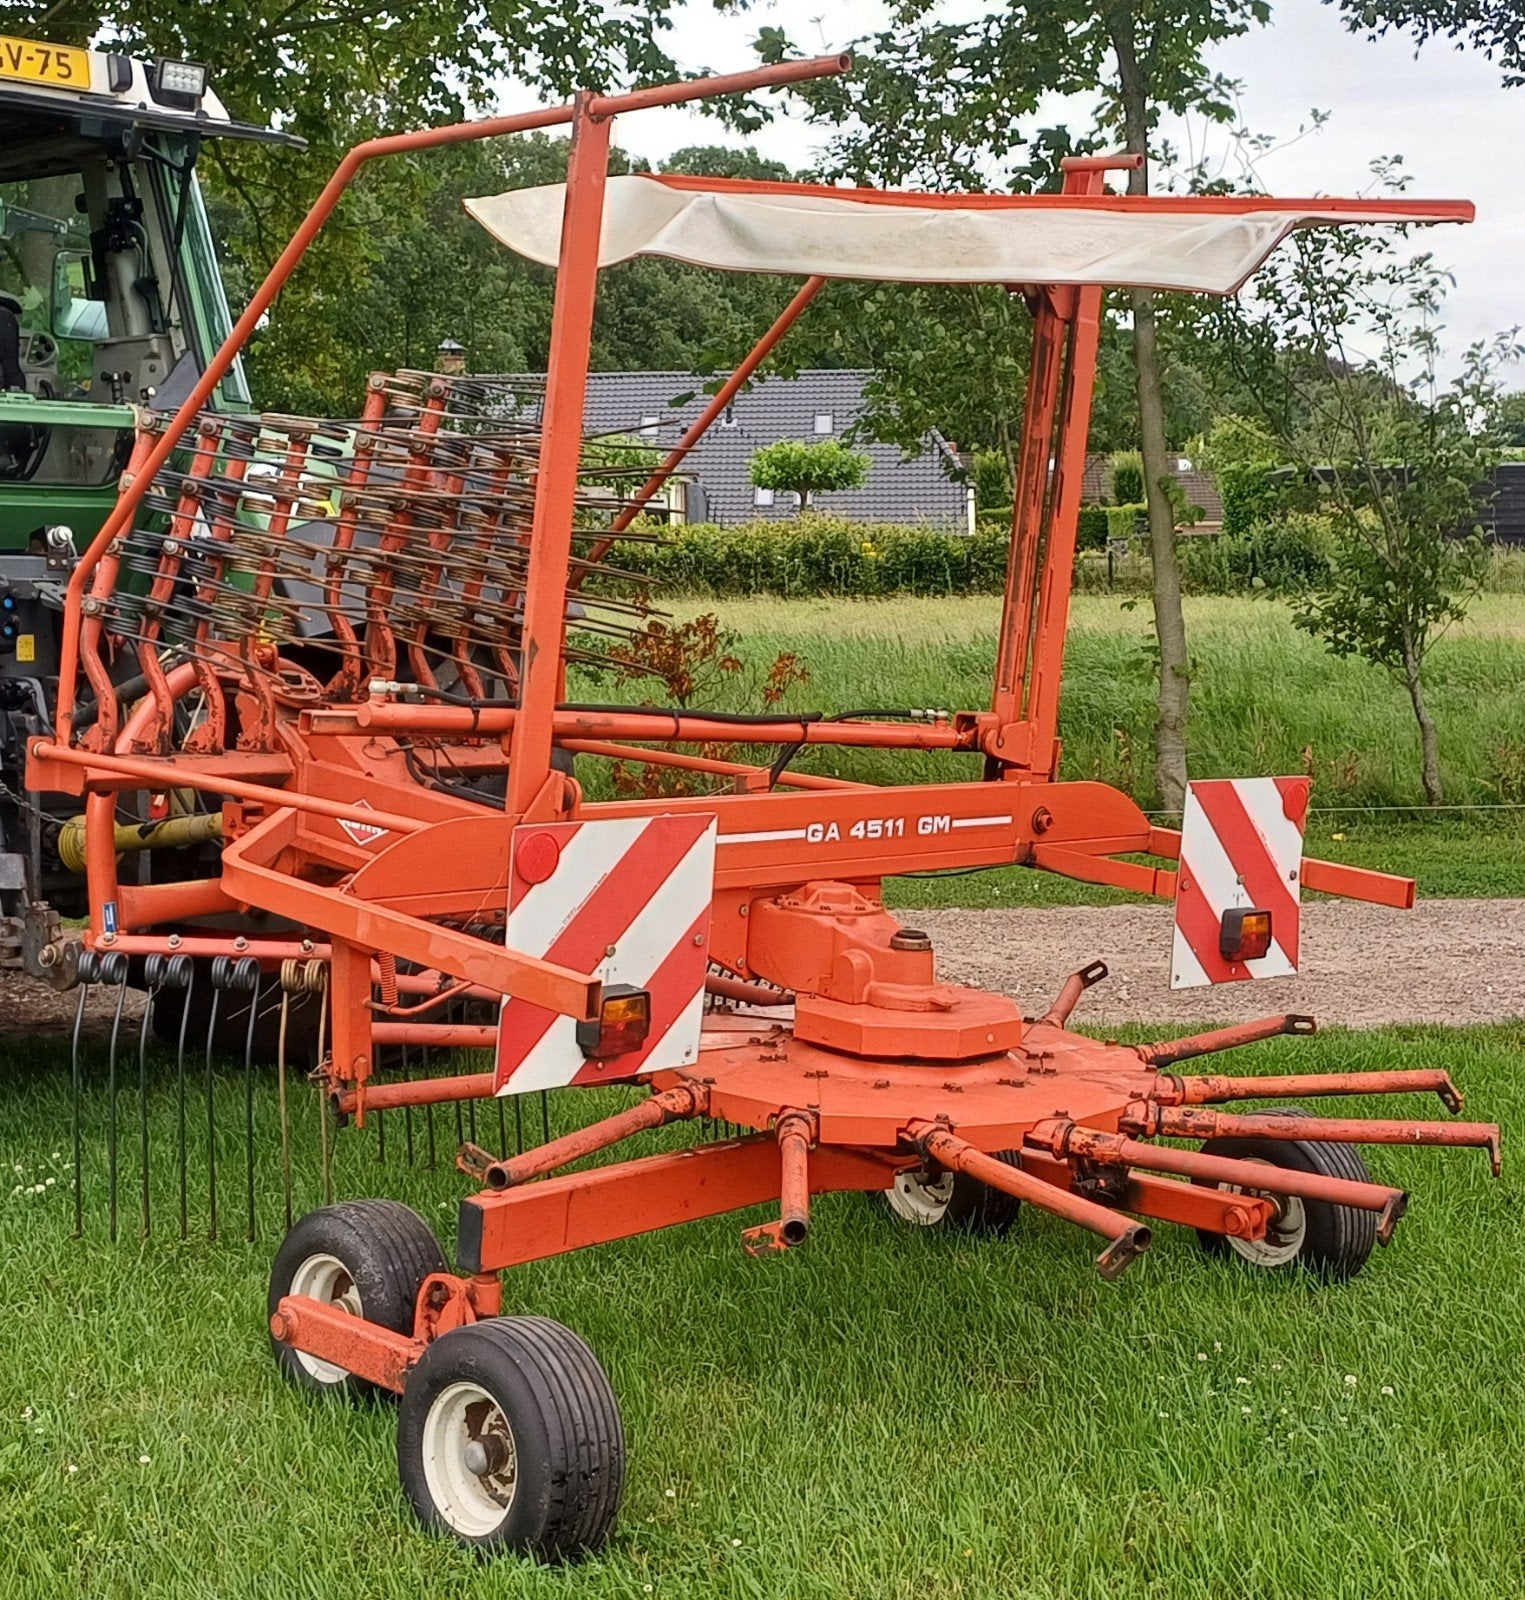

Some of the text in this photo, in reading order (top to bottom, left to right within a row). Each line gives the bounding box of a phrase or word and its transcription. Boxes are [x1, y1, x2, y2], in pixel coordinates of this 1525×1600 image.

[0, 43, 72, 79] V-75
[806, 814, 951, 843] GA 4511 GM
